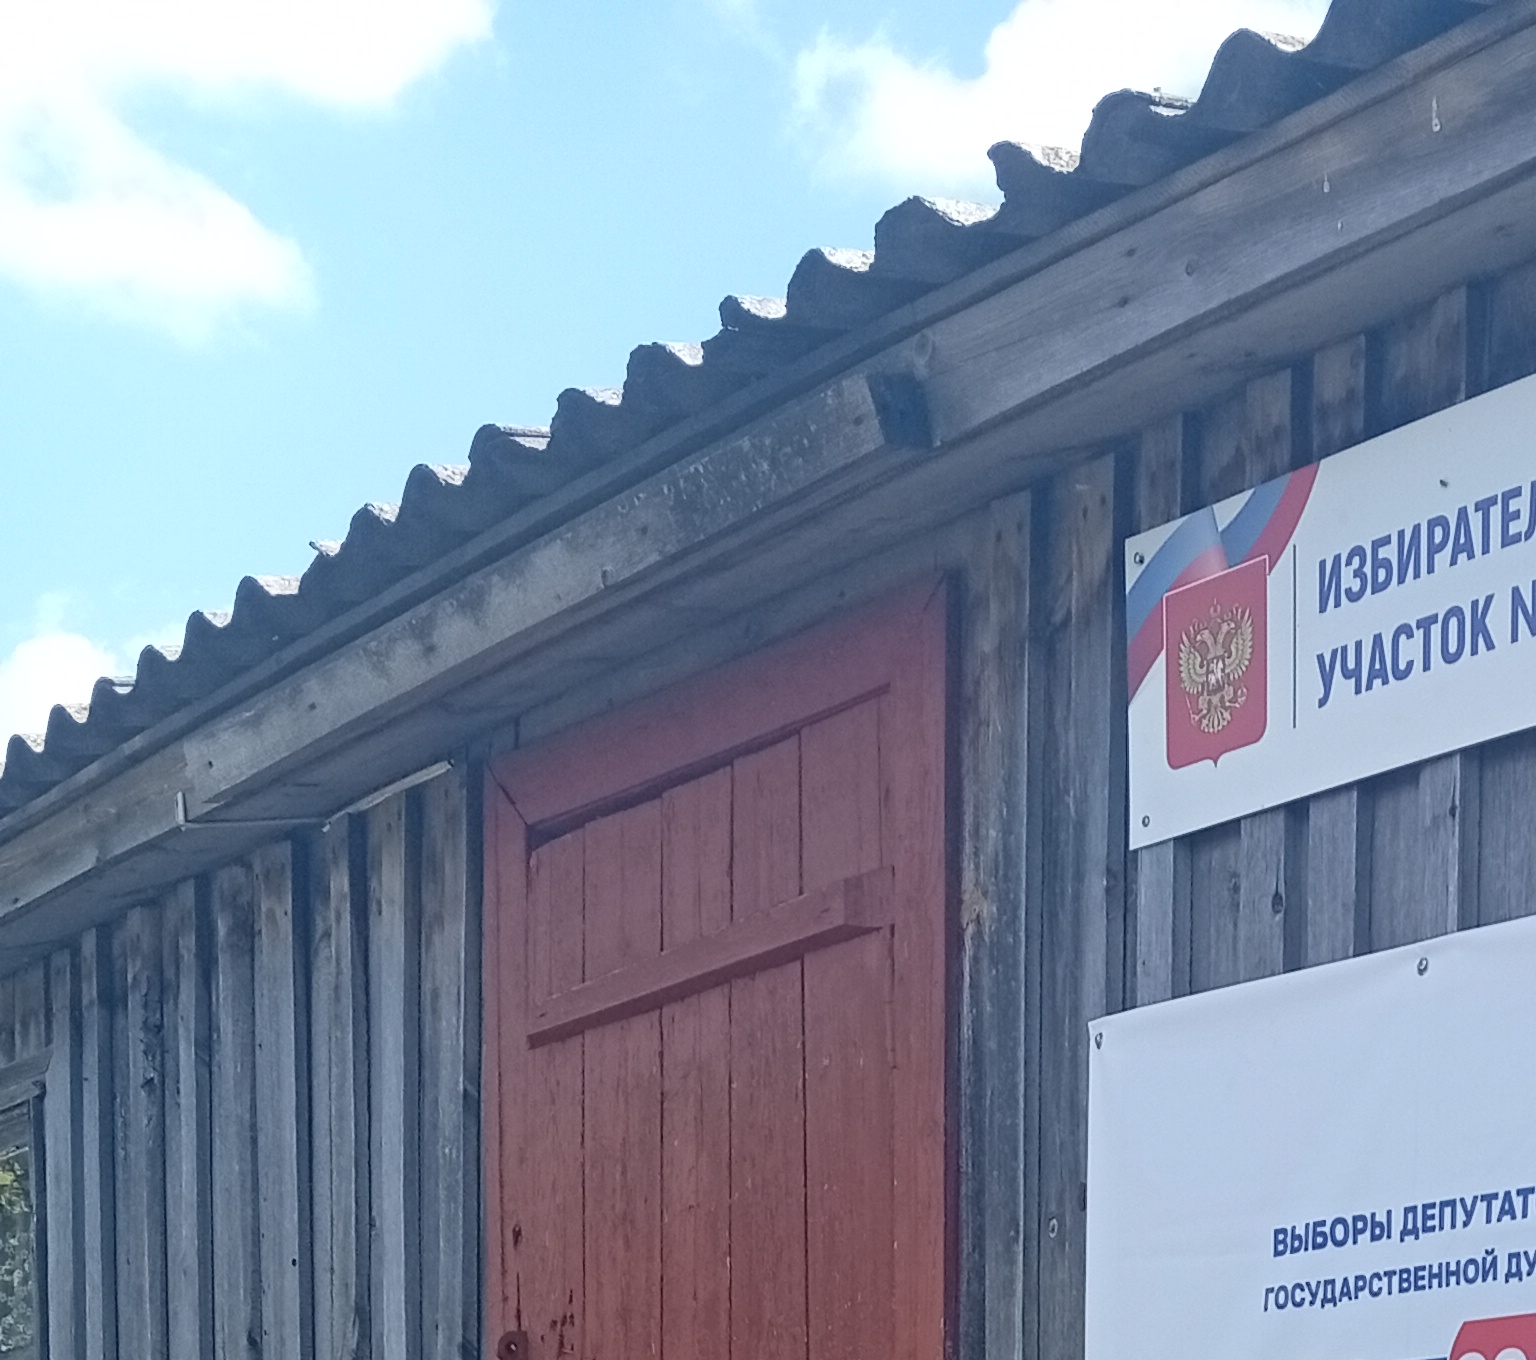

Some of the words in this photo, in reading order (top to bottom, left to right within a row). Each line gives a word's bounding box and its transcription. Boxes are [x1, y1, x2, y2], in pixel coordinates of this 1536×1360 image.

[1317, 593, 1496, 708] УЧАСТОК
[1273, 1210, 1392, 1257] ВЫБОРЫ
[1263, 1248, 1498, 1312] ГОСУДАРСТВЕННОЙ
